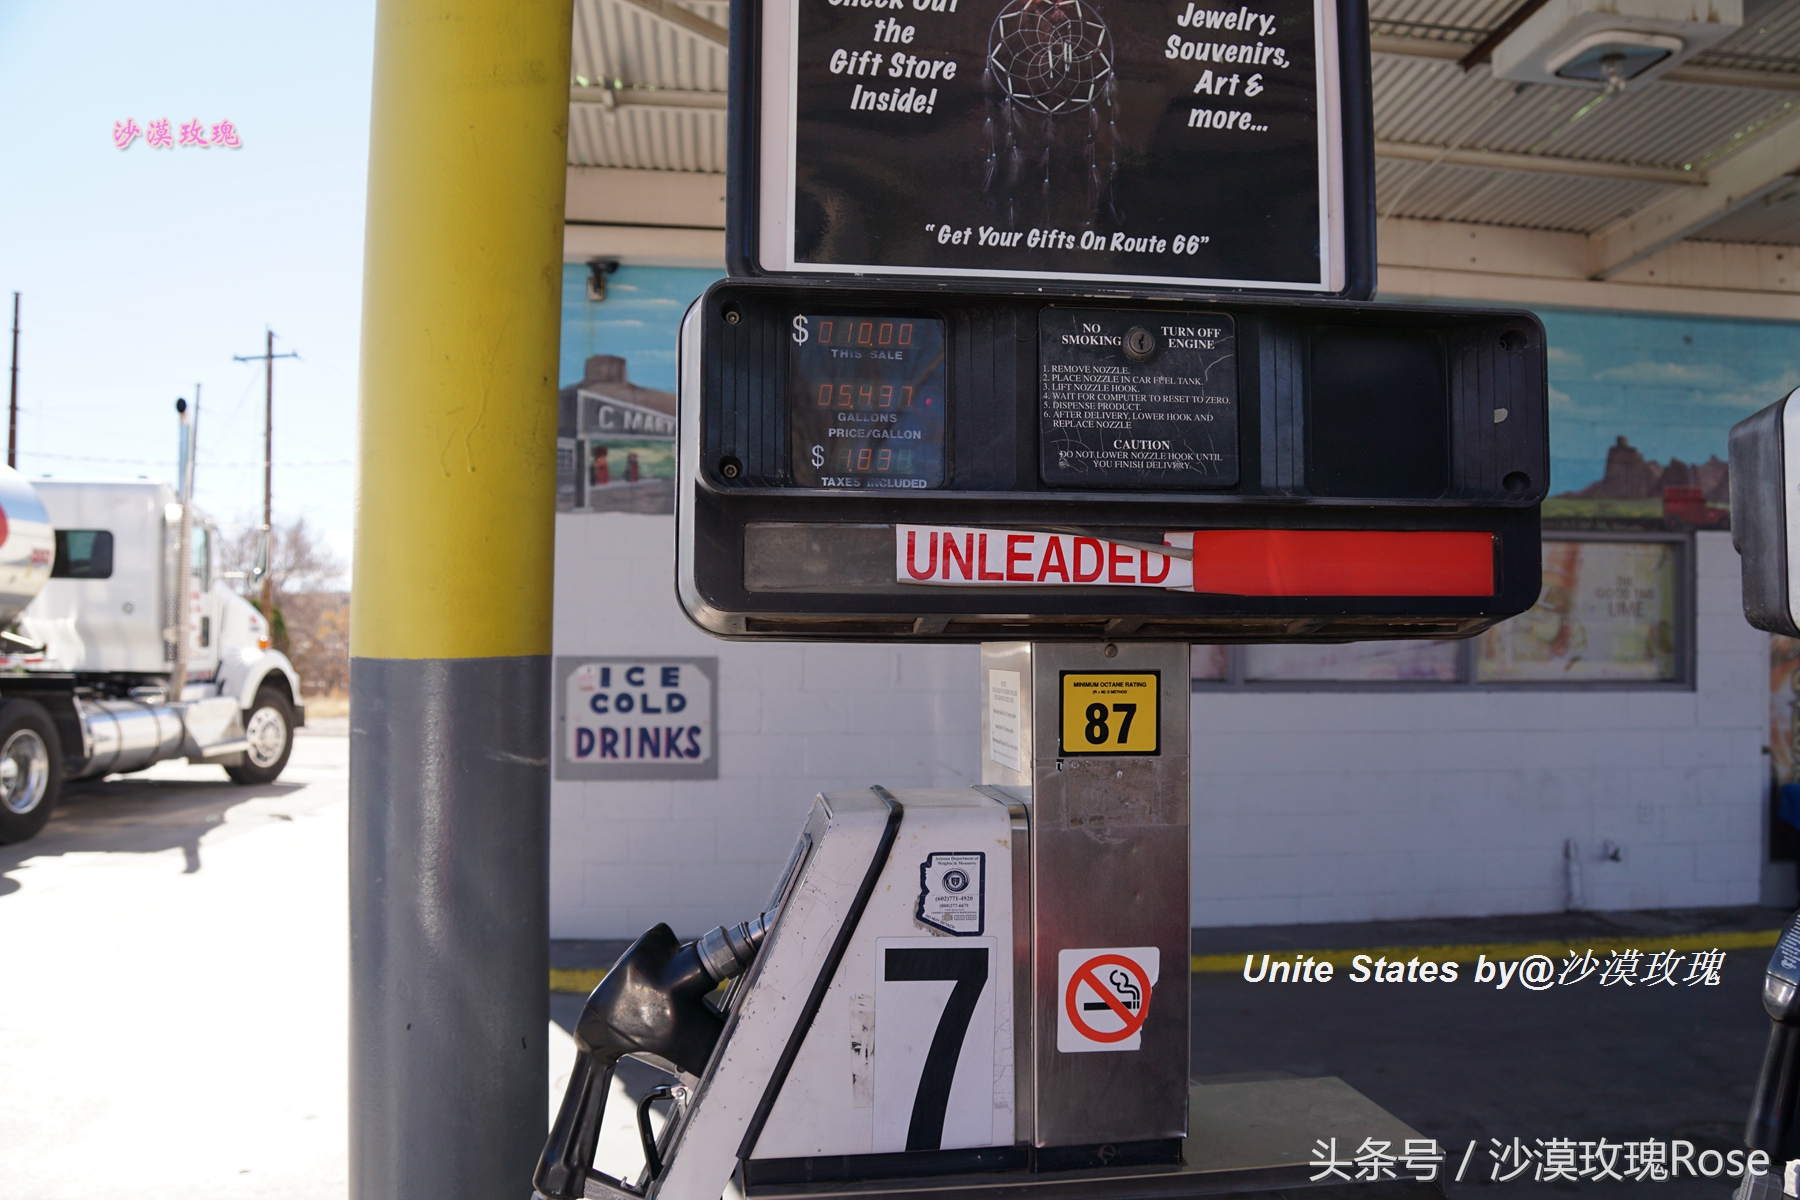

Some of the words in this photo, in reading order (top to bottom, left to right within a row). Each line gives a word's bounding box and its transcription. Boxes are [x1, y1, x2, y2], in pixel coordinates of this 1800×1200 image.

[1177, 2, 1276, 37] Jewelry,
[873, 17, 915, 44] the
[1165, 34, 1290, 69] Souvenirs,
[829, 48, 882, 76] Gift
[888, 52, 957, 80] Store
[1193, 69, 1240, 96] Art
[1244, 73, 1264, 97] &
[850, 84, 938, 114] Inside!
[1188, 108, 1268, 132] more...
[978, 226, 1023, 248] Your
[1027, 229, 1075, 250] Gifts
[1080, 231, 1105, 251] On
[1110, 232, 1166, 253] Route
[792, 314, 809, 346] $
[818, 322, 913, 346] 010.00
[1083, 323, 1101, 334] NO
[1161, 326, 1194, 337] TURN
[1197, 327, 1222, 338] OFF
[1062, 335, 1122, 346] SMOKING
[1168, 338, 1215, 350] ENGINE
[831, 349, 862, 359] THIS
[870, 350, 903, 360] SALE
[1043, 365, 1050, 373] 1.
[1051, 365, 1091, 373] REMOVE
[1093, 366, 1130, 375] NOZZLE.
[1043, 374, 1050, 382] 2.
[1052, 374, 1081, 382] PLACE
[1083, 375, 1119, 383] NOZZLE
[1132, 376, 1151, 384] CAR
[1153, 377, 1176, 385] FUEL
[1177, 377, 1204, 386] TANK.
[1043, 383, 1050, 391] 3.
[1052, 383, 1072, 391] LIFT
[1074, 384, 1110, 392] NOZZLE
[1111, 385, 1140, 393] HOOK.
[818, 384, 913, 409] 05.437
[1052, 393, 1076, 401] WAIT
[1077, 393, 1095, 401] FOR
[1097, 393, 1147, 402] COMPUTER
[1163, 395, 1190, 403] RESET
[1192, 396, 1204, 404] TO
[1205, 396, 1231, 405] ZERO.
[1053, 402, 1096, 410] DISPENSE
[1098, 403, 1142, 411] PRODUCT.
[599, 405, 615, 430] C
[837, 412, 898, 423] GALLONS
[1053, 411, 1082, 419] AFTER
[1133, 412, 1165, 420] LOWER
[1167, 413, 1192, 421] HOOK
[1194, 414, 1214, 422] AND
[1053, 420, 1094, 428] REPLACE
[1096, 421, 1132, 429] NOZZLE
[828, 428, 921, 440] PRICE/GALLON
[1113, 439, 1170, 450] CAUTION
[811, 444, 825, 469] $
[1060, 450, 1073, 458] DO
[1076, 451, 1094, 459] NOT
[1096, 451, 1129, 460] LOWER
[1131, 452, 1166, 460] NOZZLE
[1168, 453, 1194, 461] HOOK
[1196, 453, 1223, 461] UNTIL
[1093, 460, 1113, 468] YOU
[1115, 461, 1144, 469] FINISH
[821, 477, 861, 487] TAXES
[867, 478, 928, 489] INCLUDED
[906, 530, 1171, 584] UNLEADED
[601, 666, 680, 688] ICE
[590, 693, 687, 714] COLD
[1085, 702, 1137, 745] 87
[576, 725, 701, 759] DRINKS
[885, 948, 989, 1151] 7
